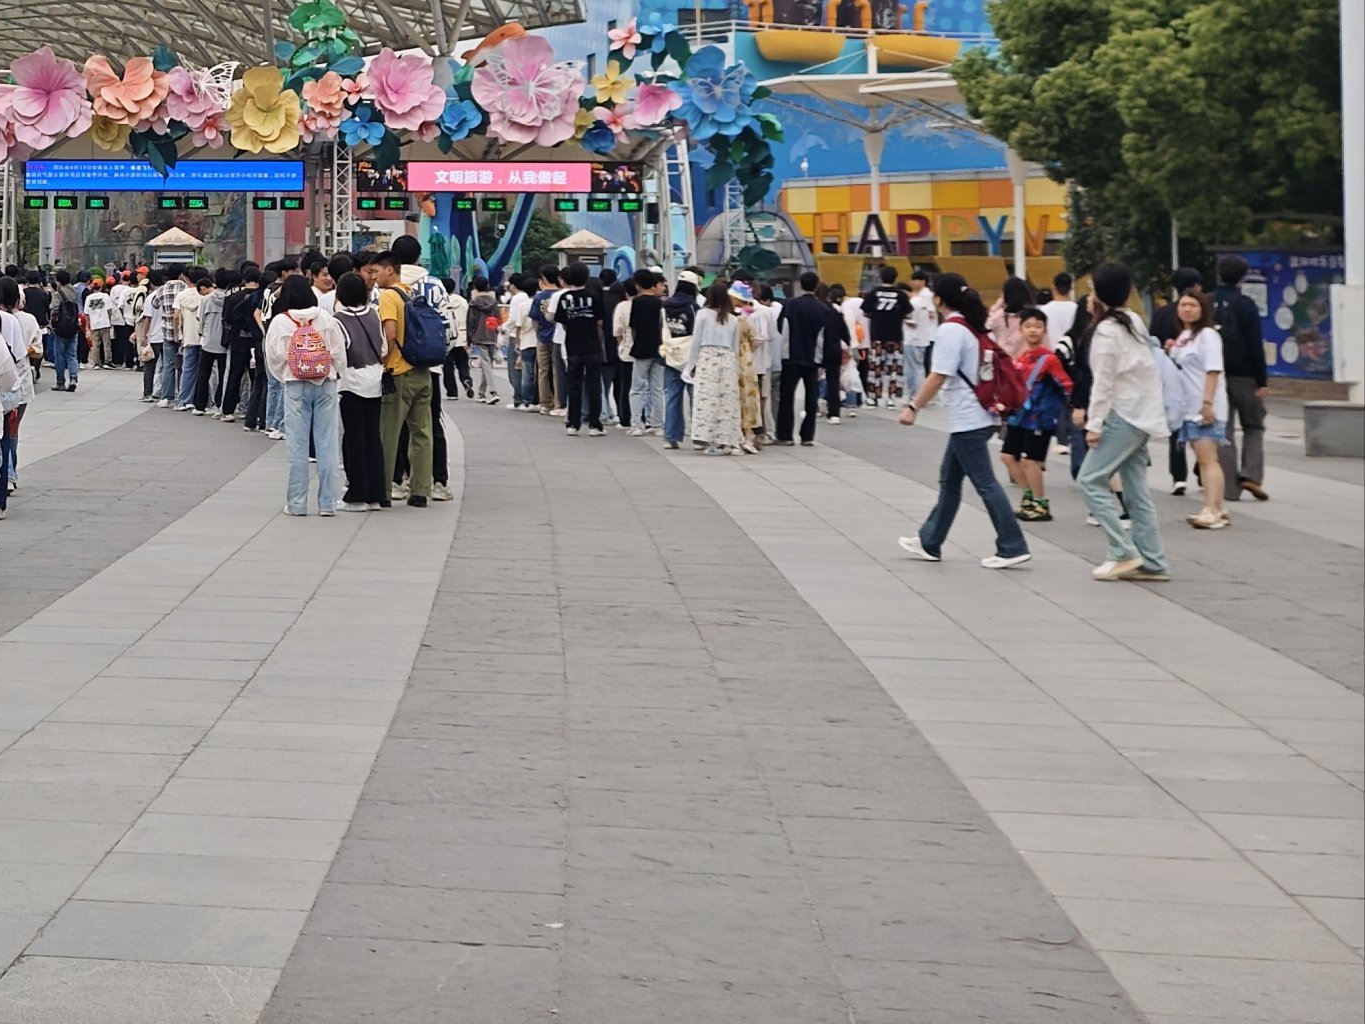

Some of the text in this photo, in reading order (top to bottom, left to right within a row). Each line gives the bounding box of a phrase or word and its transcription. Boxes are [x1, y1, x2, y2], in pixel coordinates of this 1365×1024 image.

[435, 170, 567, 185] 文明旅游，从我做起
[812, 213, 1009, 256] HAPPY
